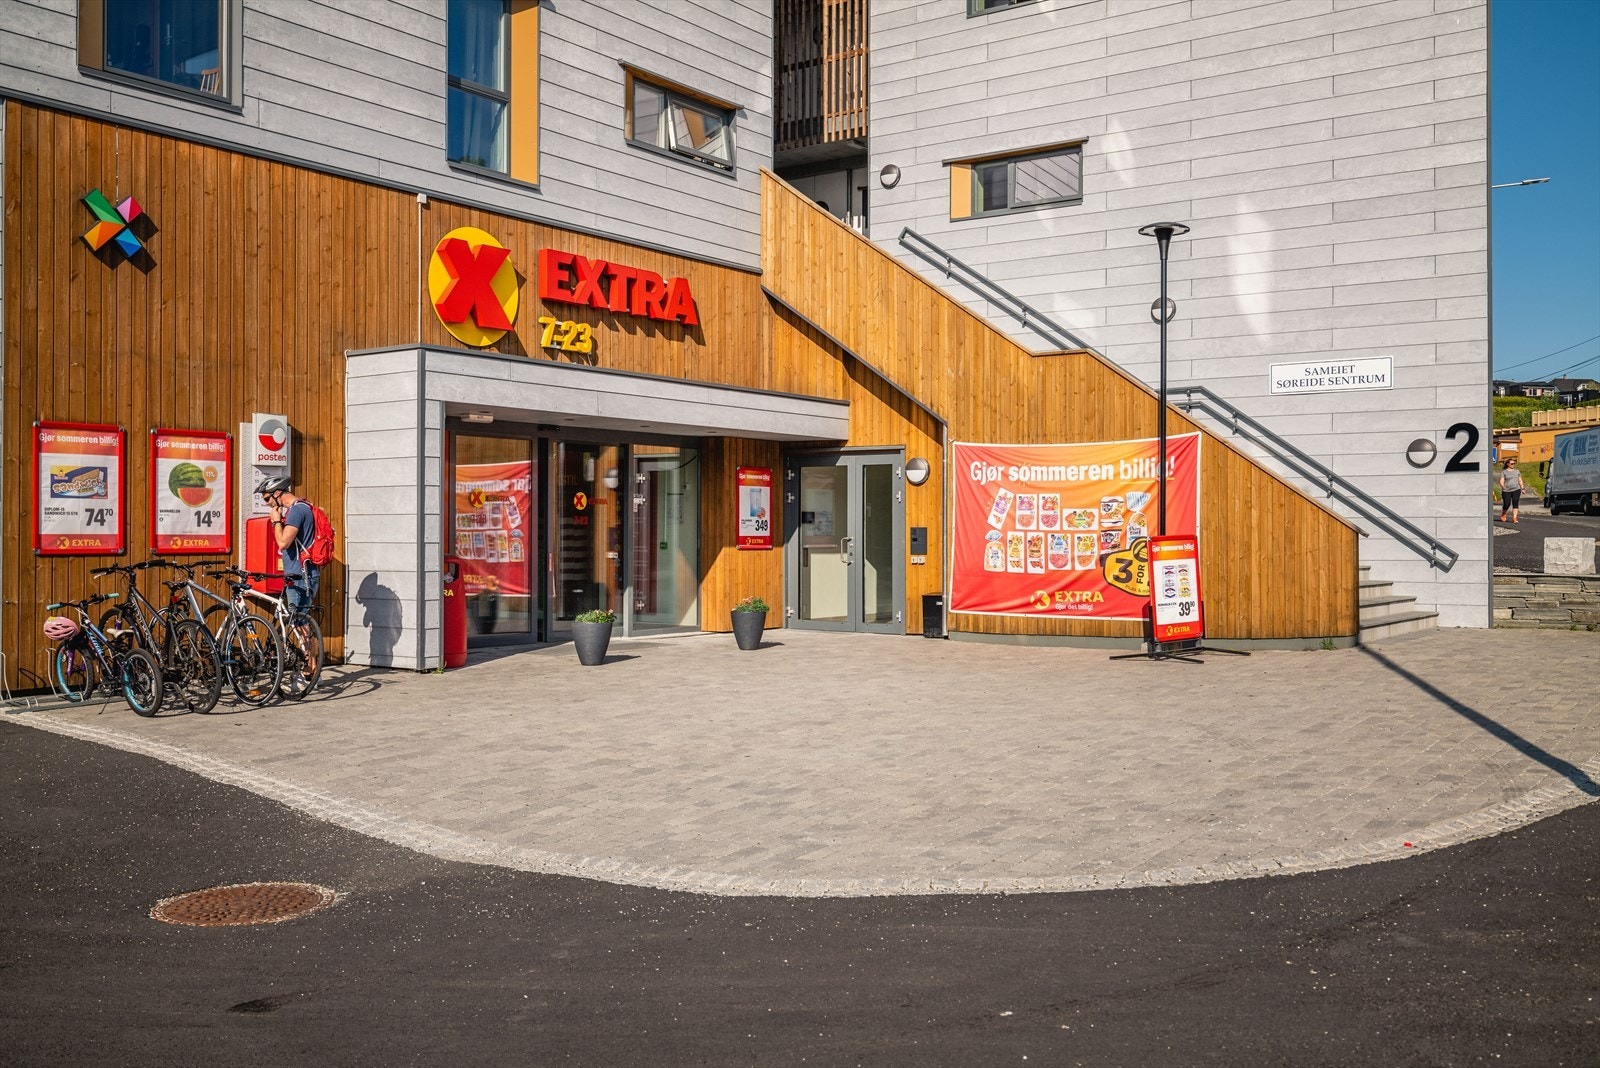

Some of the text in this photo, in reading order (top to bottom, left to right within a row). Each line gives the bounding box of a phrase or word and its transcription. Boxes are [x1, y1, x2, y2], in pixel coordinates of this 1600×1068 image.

[538, 247, 699, 326] EXTRA
[537, 316, 593, 354] 7-23
[1304, 364, 1356, 377] SAMEIET
[1276, 374, 1386, 389] SØREIDE SENTRUM
[56, 435, 98, 444] sommeren
[99, 436, 119, 447] billig!
[170, 441, 208, 450] sommeren
[208, 443, 226, 453] billig!
[1444, 422, 1480, 473] 2
[257, 453, 287, 462] posten
[970, 461, 1005, 486] Gjør
[1008, 463, 1115, 482] sommeren
[85, 508, 114, 527] 74 70
[194, 510, 221, 528] 14 90
[71, 539, 102, 547] EXTRA
[183, 539, 210, 547] EXTRA
[1112, 557, 1146, 584] 3 FOR
[1054, 590, 1105, 603] EXTRA
[1178, 601, 1190, 617] 39
[1173, 625, 1191, 634] EXTRA
